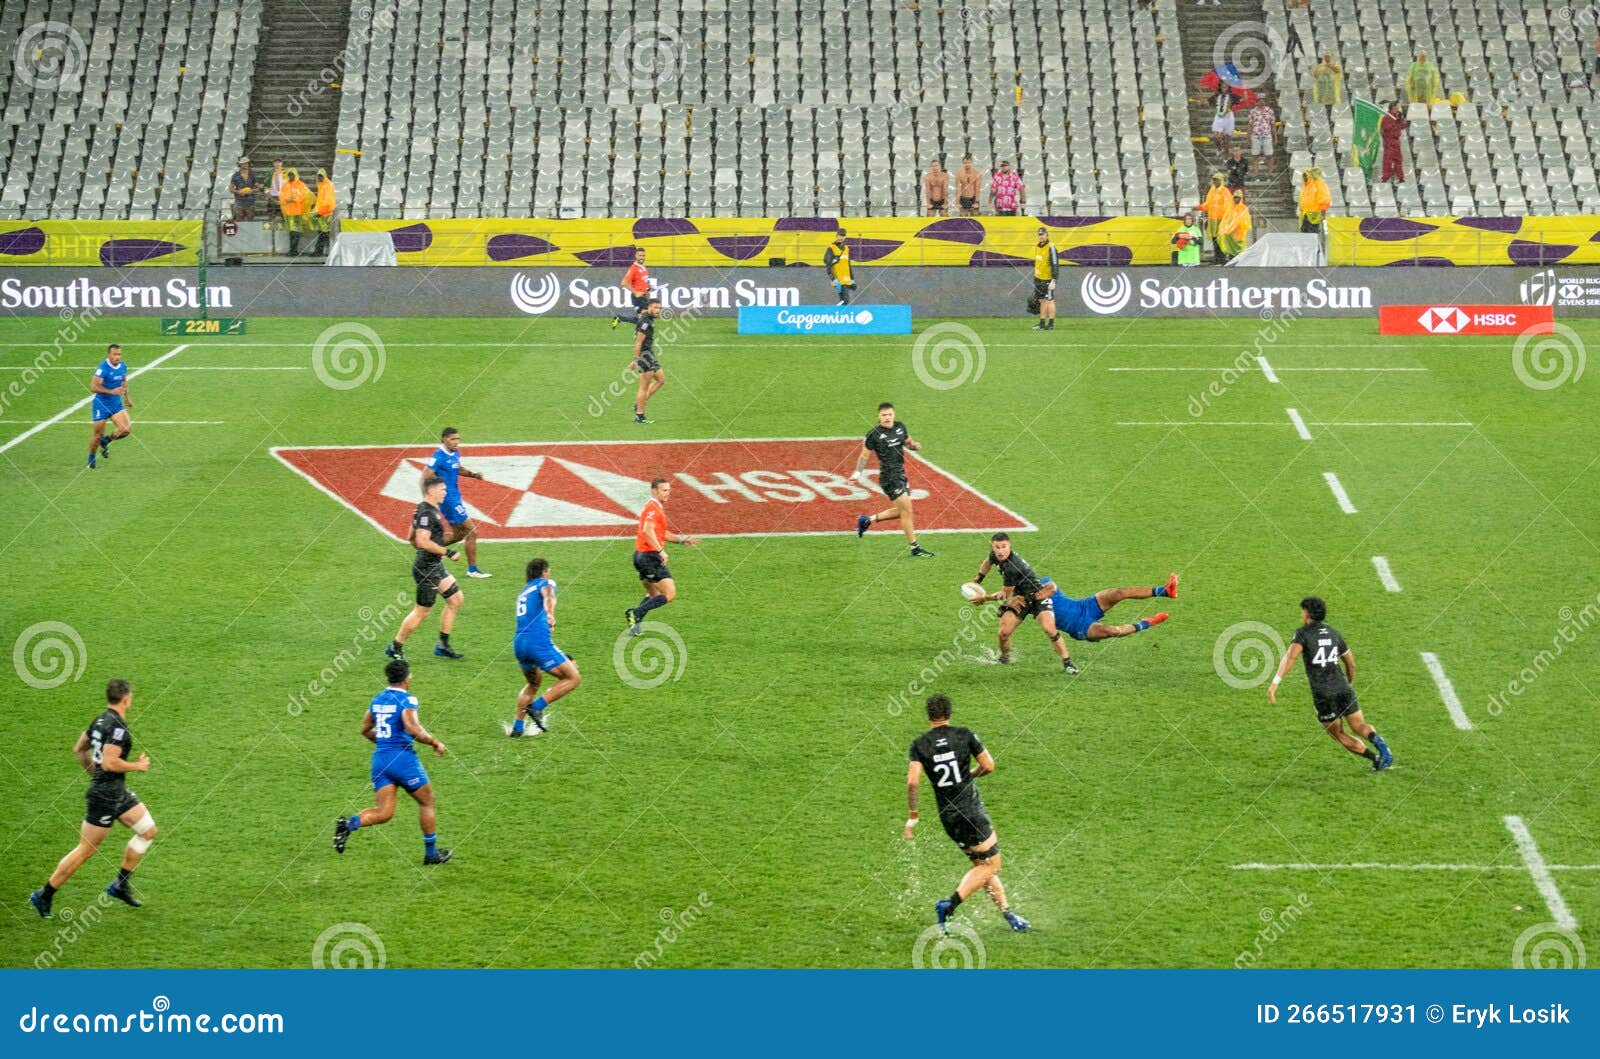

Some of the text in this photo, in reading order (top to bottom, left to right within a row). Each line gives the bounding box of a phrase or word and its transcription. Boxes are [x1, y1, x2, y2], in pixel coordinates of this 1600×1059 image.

[2, 278, 232, 308] Southern Sun
[569, 278, 799, 308] Souhern Sun
[1141, 278, 1372, 308] Southern Sun
[185, 320, 220, 333] 22M
[777, 310, 855, 330] Capgemini
[1473, 314, 1517, 326] HSBC
[516, 595, 527, 617] 6
[1312, 645, 1339, 668] 44
[375, 713, 392, 738] 15
[933, 760, 962, 788] 21
